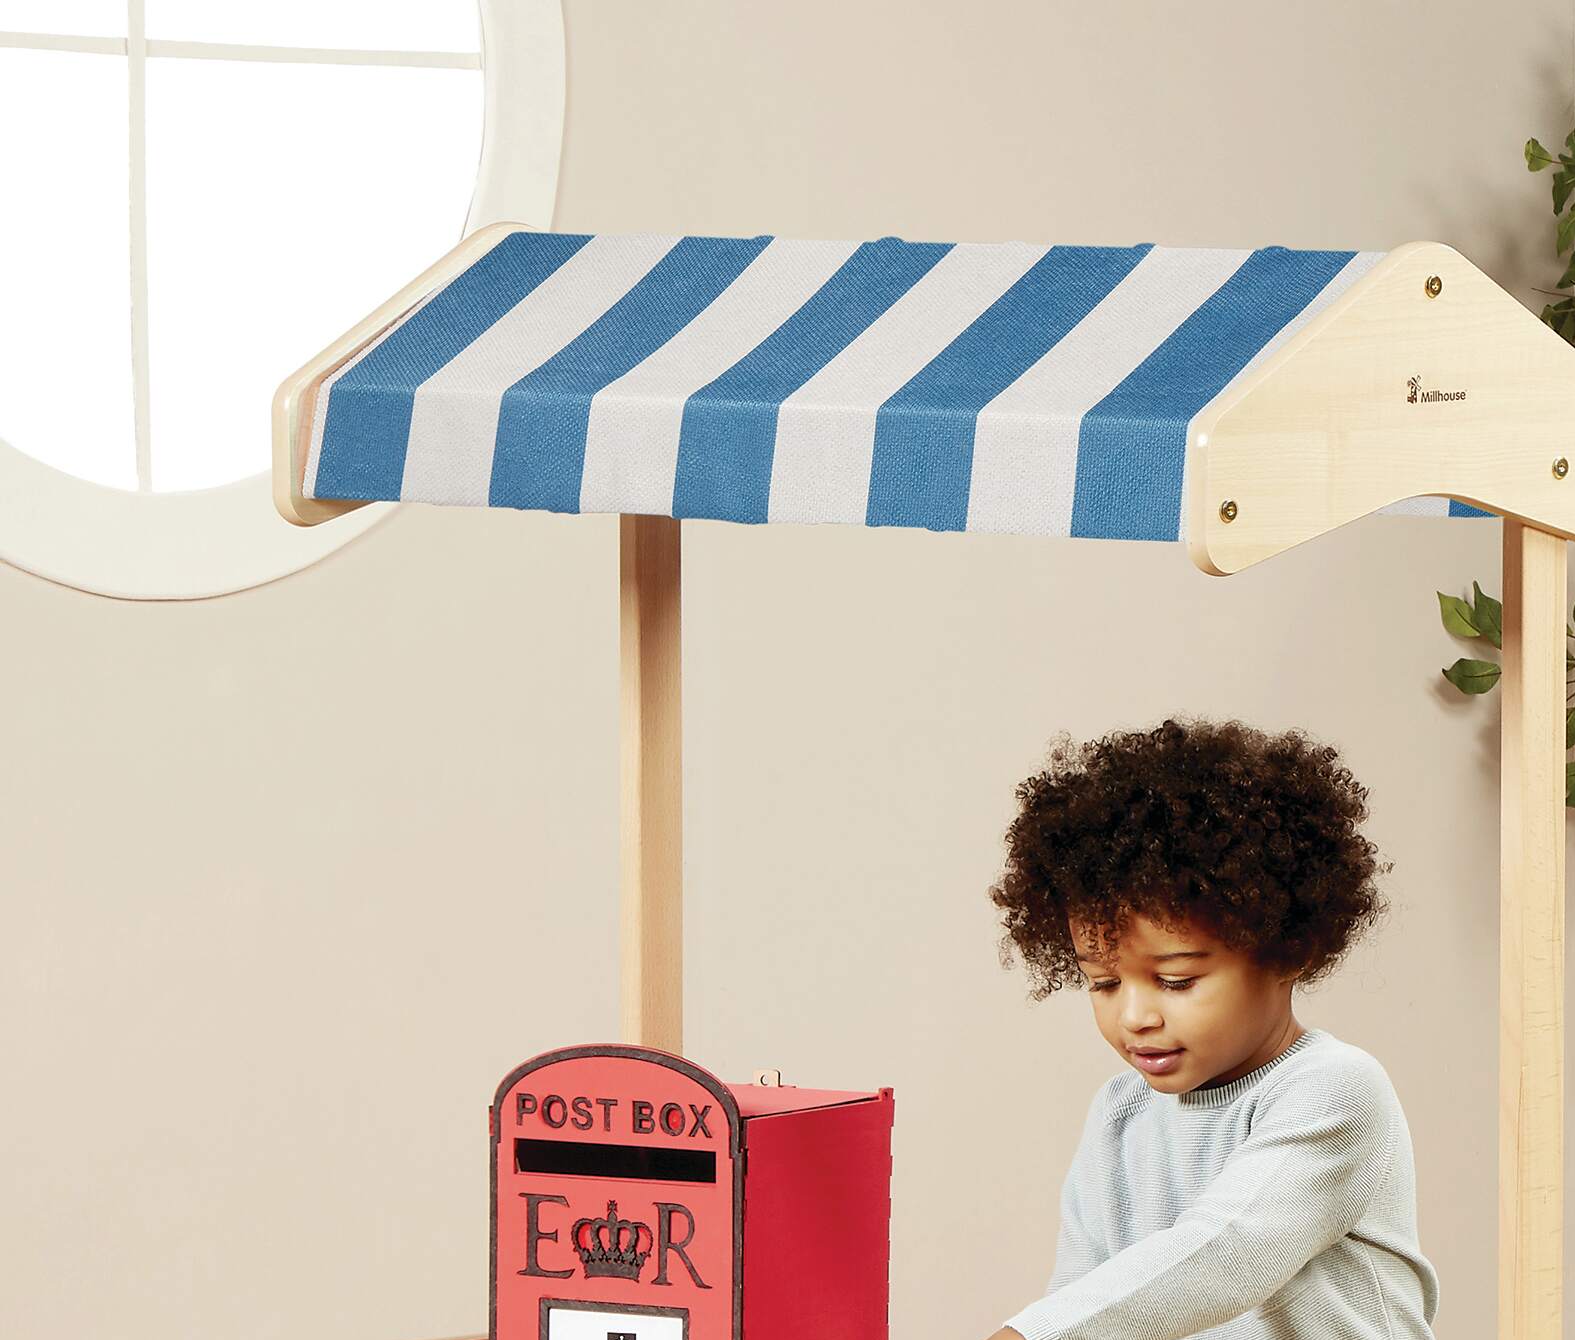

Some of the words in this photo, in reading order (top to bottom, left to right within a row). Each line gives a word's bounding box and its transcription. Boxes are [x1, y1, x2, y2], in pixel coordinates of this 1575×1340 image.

[1420, 390, 1466, 403] Millhouse
[516, 1093, 618, 1132] POST
[632, 1100, 713, 1139] BOX
